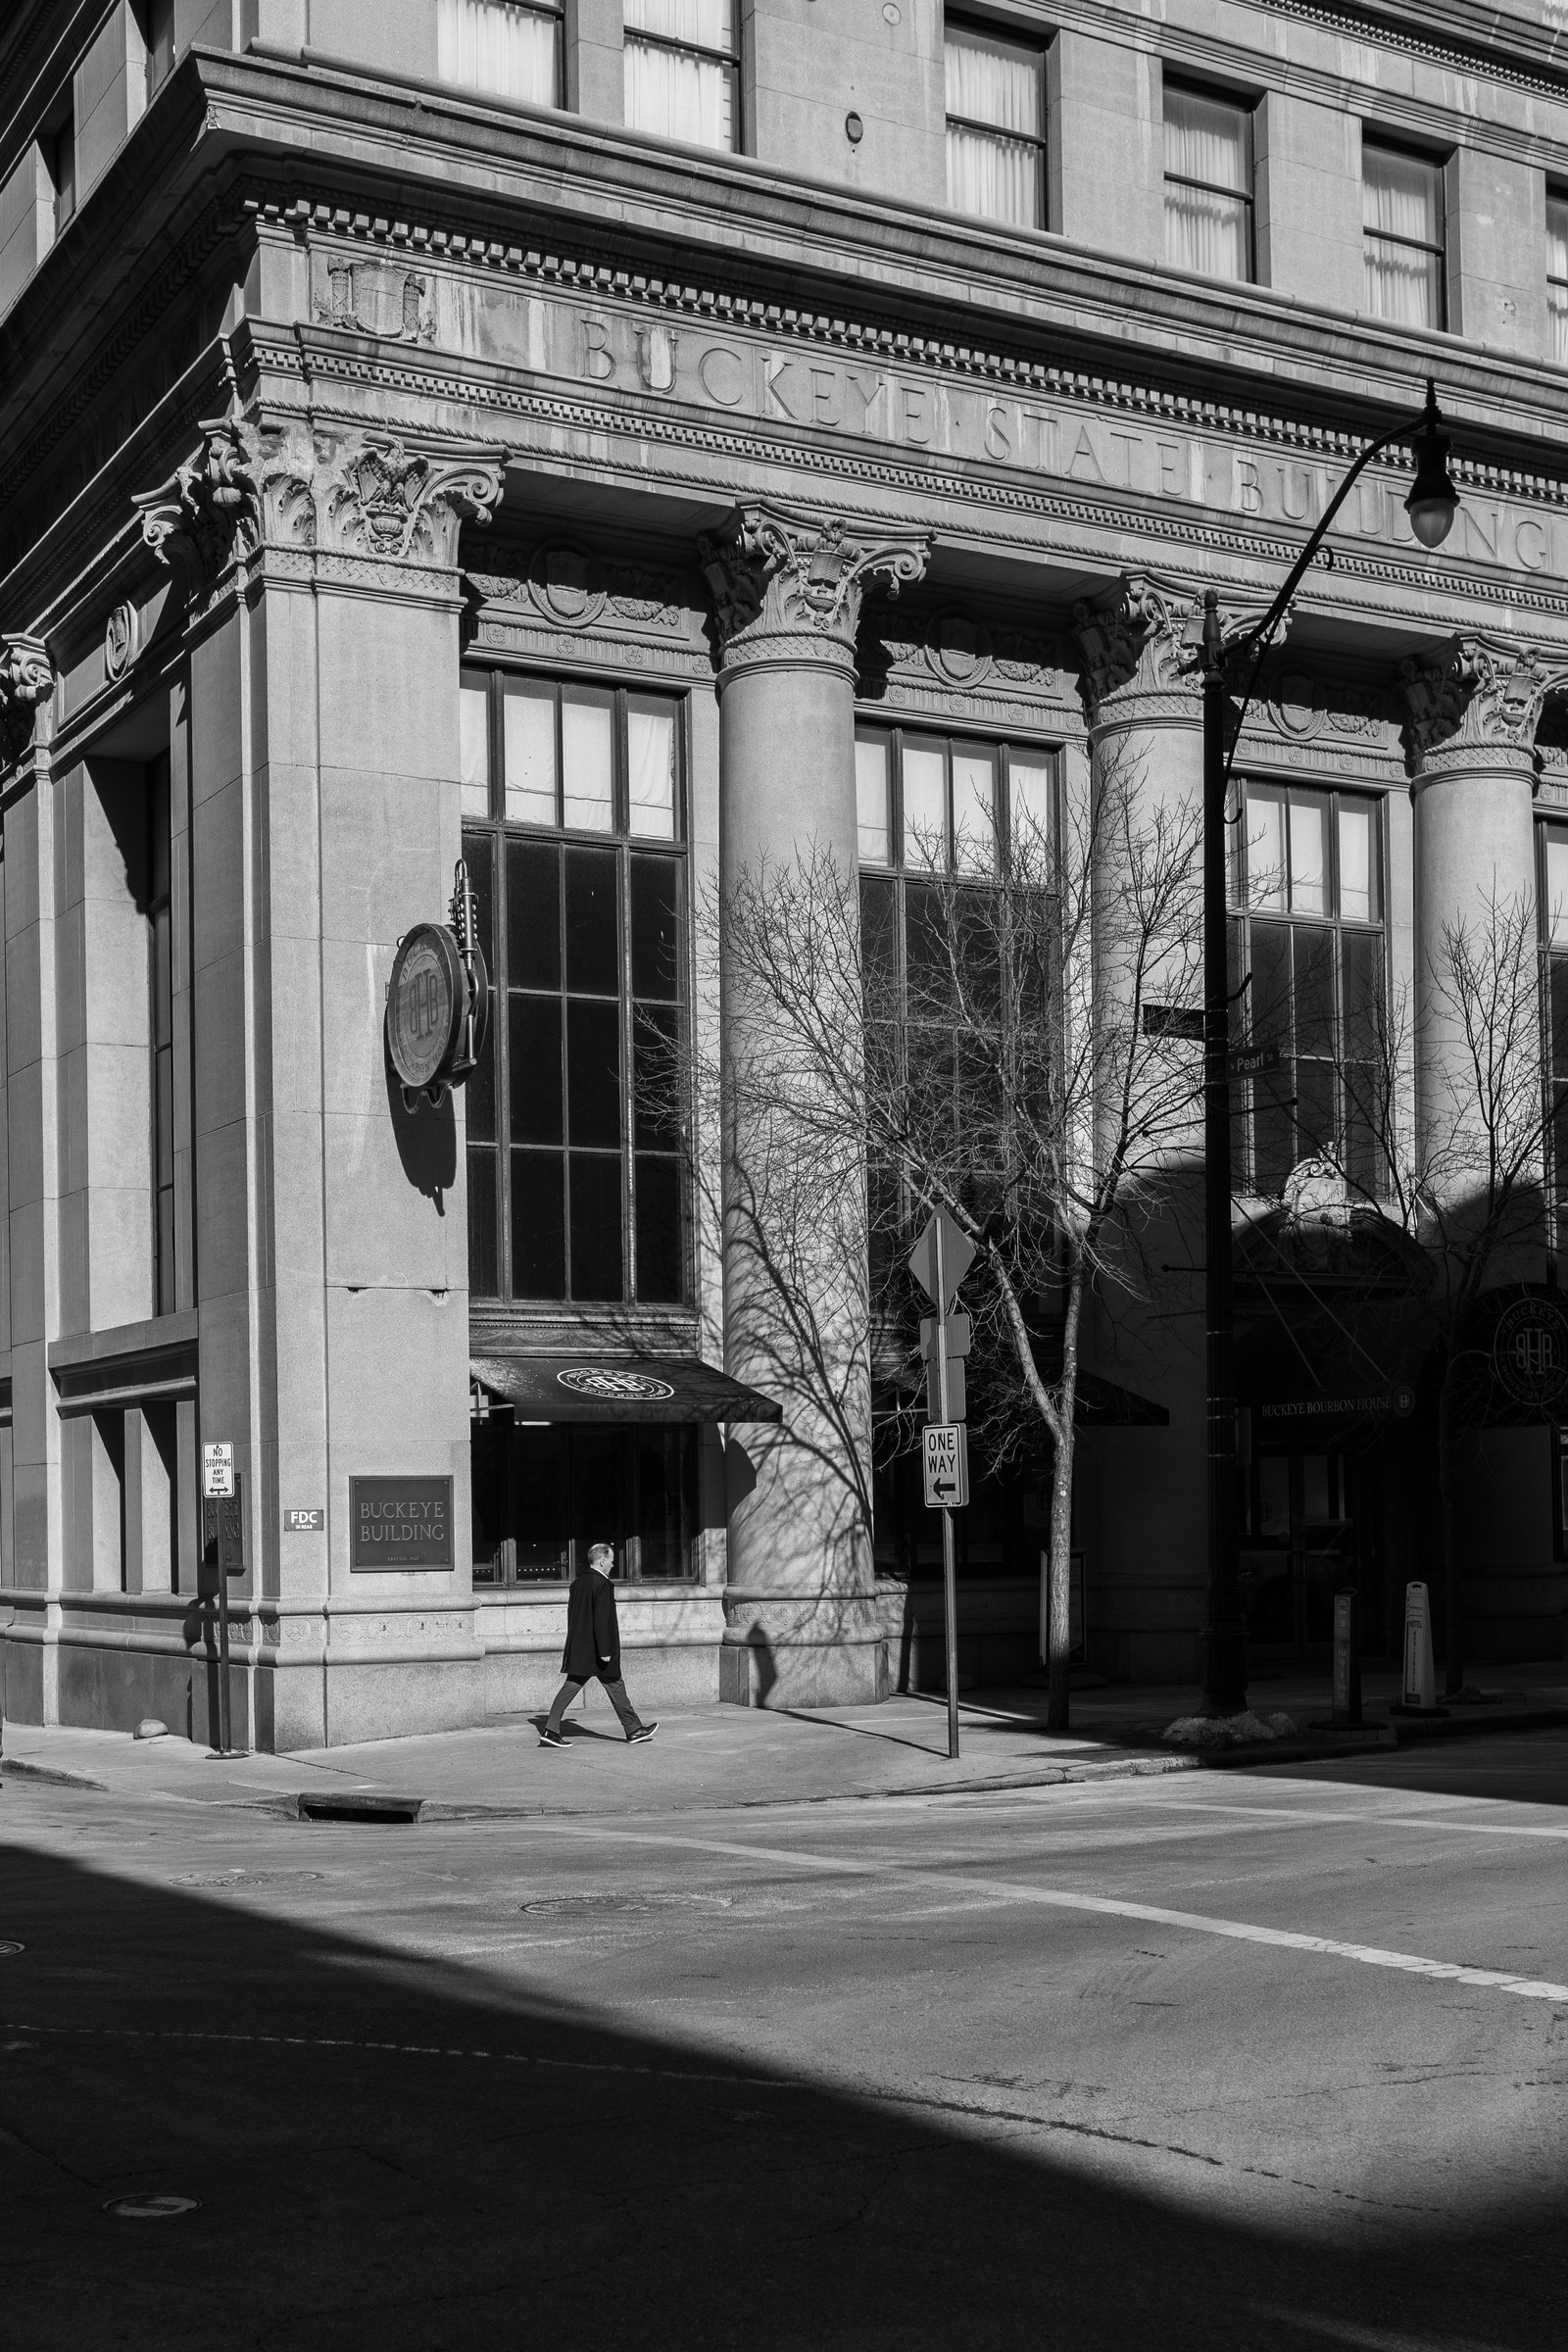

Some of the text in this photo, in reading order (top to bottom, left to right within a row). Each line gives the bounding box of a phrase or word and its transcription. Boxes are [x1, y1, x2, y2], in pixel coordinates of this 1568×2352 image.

[580, 318, 1546, 569] BUCKEYE STATE BUILDNG
[1237, 1052, 1264, 1072] Pearl
[1261, 1396, 1393, 1417] BUCKEYE BOURBON HOUSE
[928, 1433, 955, 1451] ONE
[213, 1447, 223, 1457] NO
[205, 1458, 231, 1468] STOPPING
[928, 1454, 956, 1473] WAY
[212, 1476, 225, 1485] TIME
[290, 1511, 318, 1524] FDC
[360, 1501, 445, 1519] BUCKEYE
[360, 1525, 445, 1543] BUILDING
